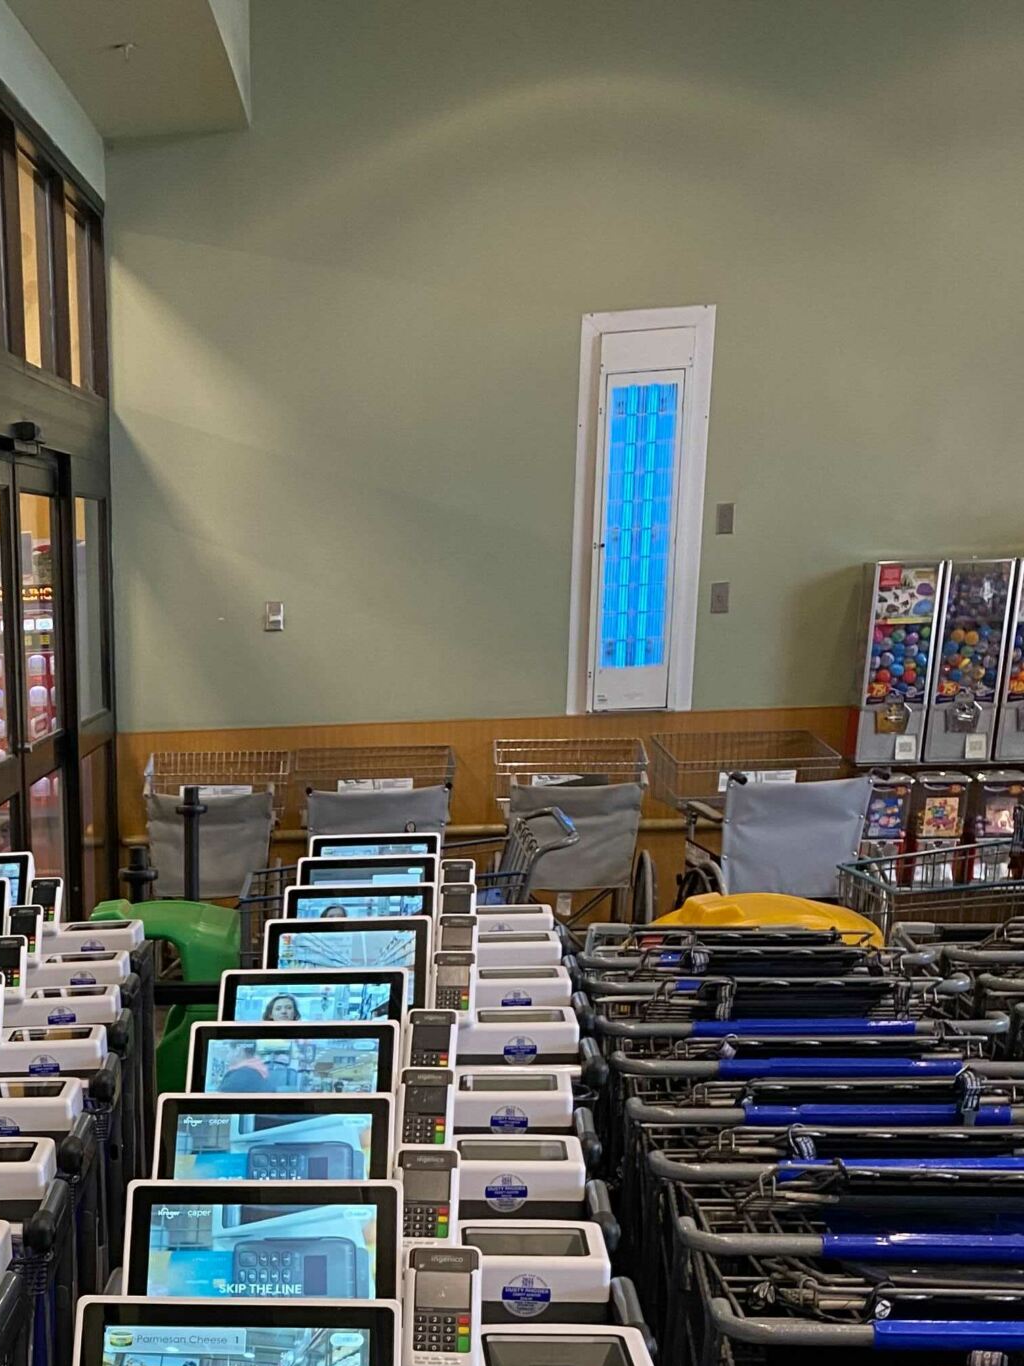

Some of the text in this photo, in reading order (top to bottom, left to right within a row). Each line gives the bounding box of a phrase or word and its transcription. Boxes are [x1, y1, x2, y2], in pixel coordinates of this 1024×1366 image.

[219, 1283, 303, 1294] SKIP THE LINE
[136, 1334, 187, 1344] Parmesan
[189, 1335, 228, 1344] Cheese
